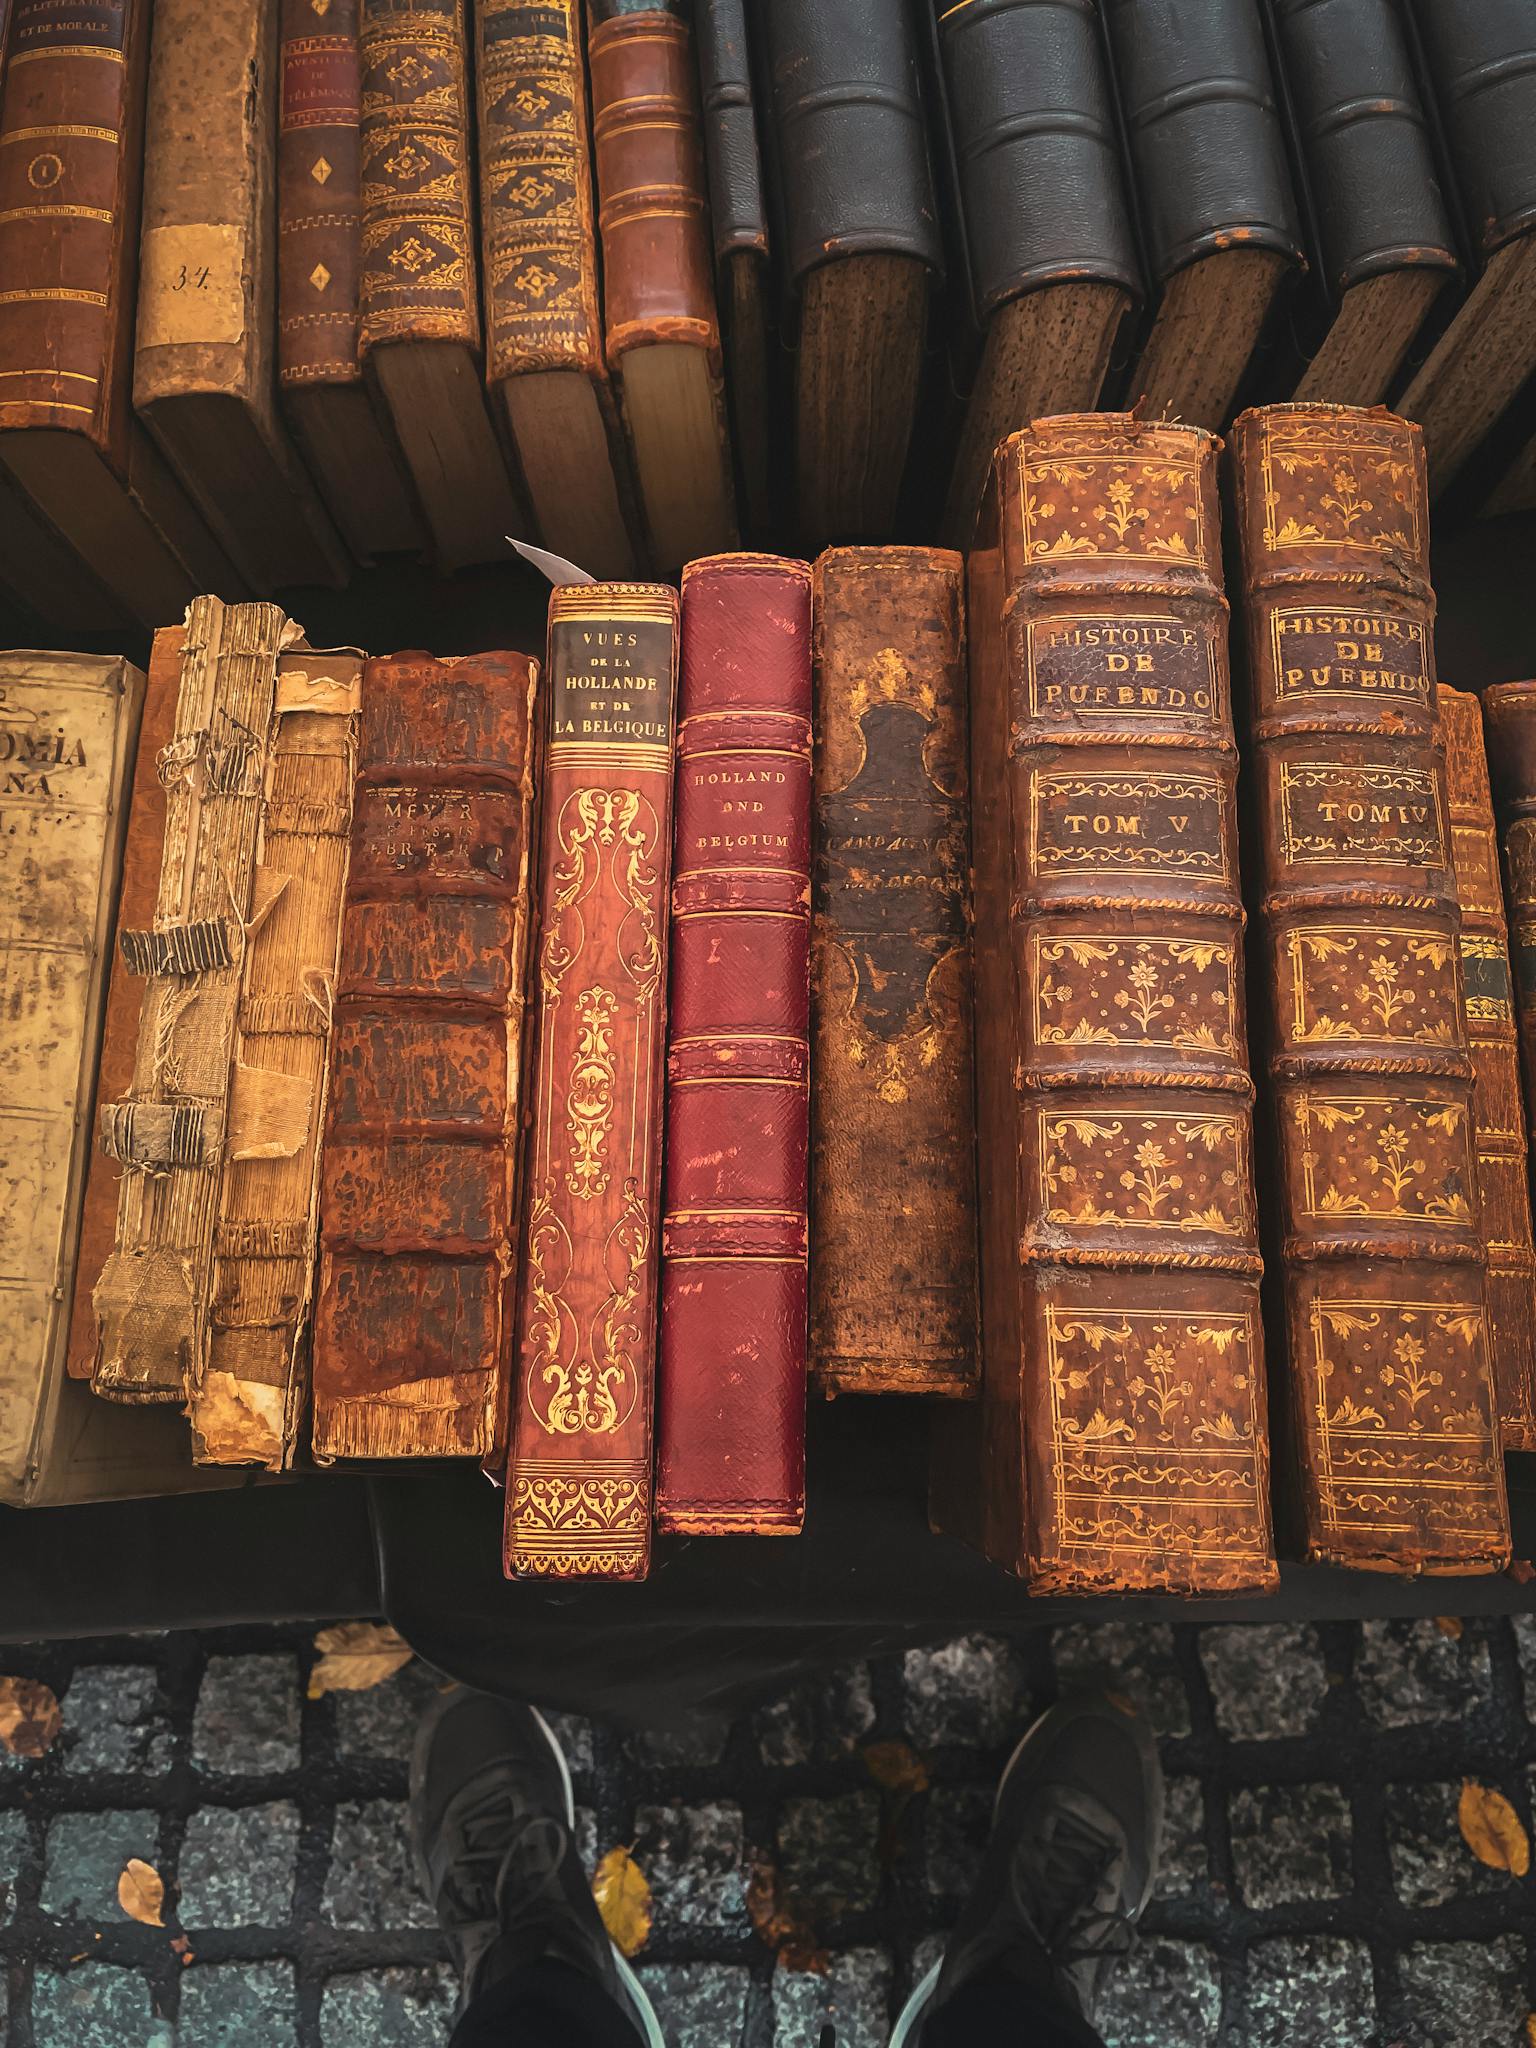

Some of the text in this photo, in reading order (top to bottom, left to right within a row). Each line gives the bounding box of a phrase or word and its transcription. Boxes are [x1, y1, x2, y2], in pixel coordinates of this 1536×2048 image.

[56, 21, 110, 33] MORALE
[583, 632, 637, 647] VUES
[1050, 627, 1199, 648] HISTOIRE
[1279, 616, 1423, 643] HISTOIRE
[1334, 640, 1385, 663] DE
[590, 658, 631, 668] DE LA
[1105, 653, 1155, 673] DE
[566, 676, 657, 691] HOLLANDE
[1286, 666, 1430, 693] PUFENDO
[590, 701, 631, 712] ET DE
[1046, 684, 1211, 709] PUFENDO
[555, 719, 667, 739] LA BELGIQUE
[695, 771, 786, 786] HOLLAND
[722, 801, 763, 813] AND
[1317, 802, 1428, 824] TOM IV
[1064, 815, 1189, 835] TOM V
[696, 834, 789, 849] BELGIUM
